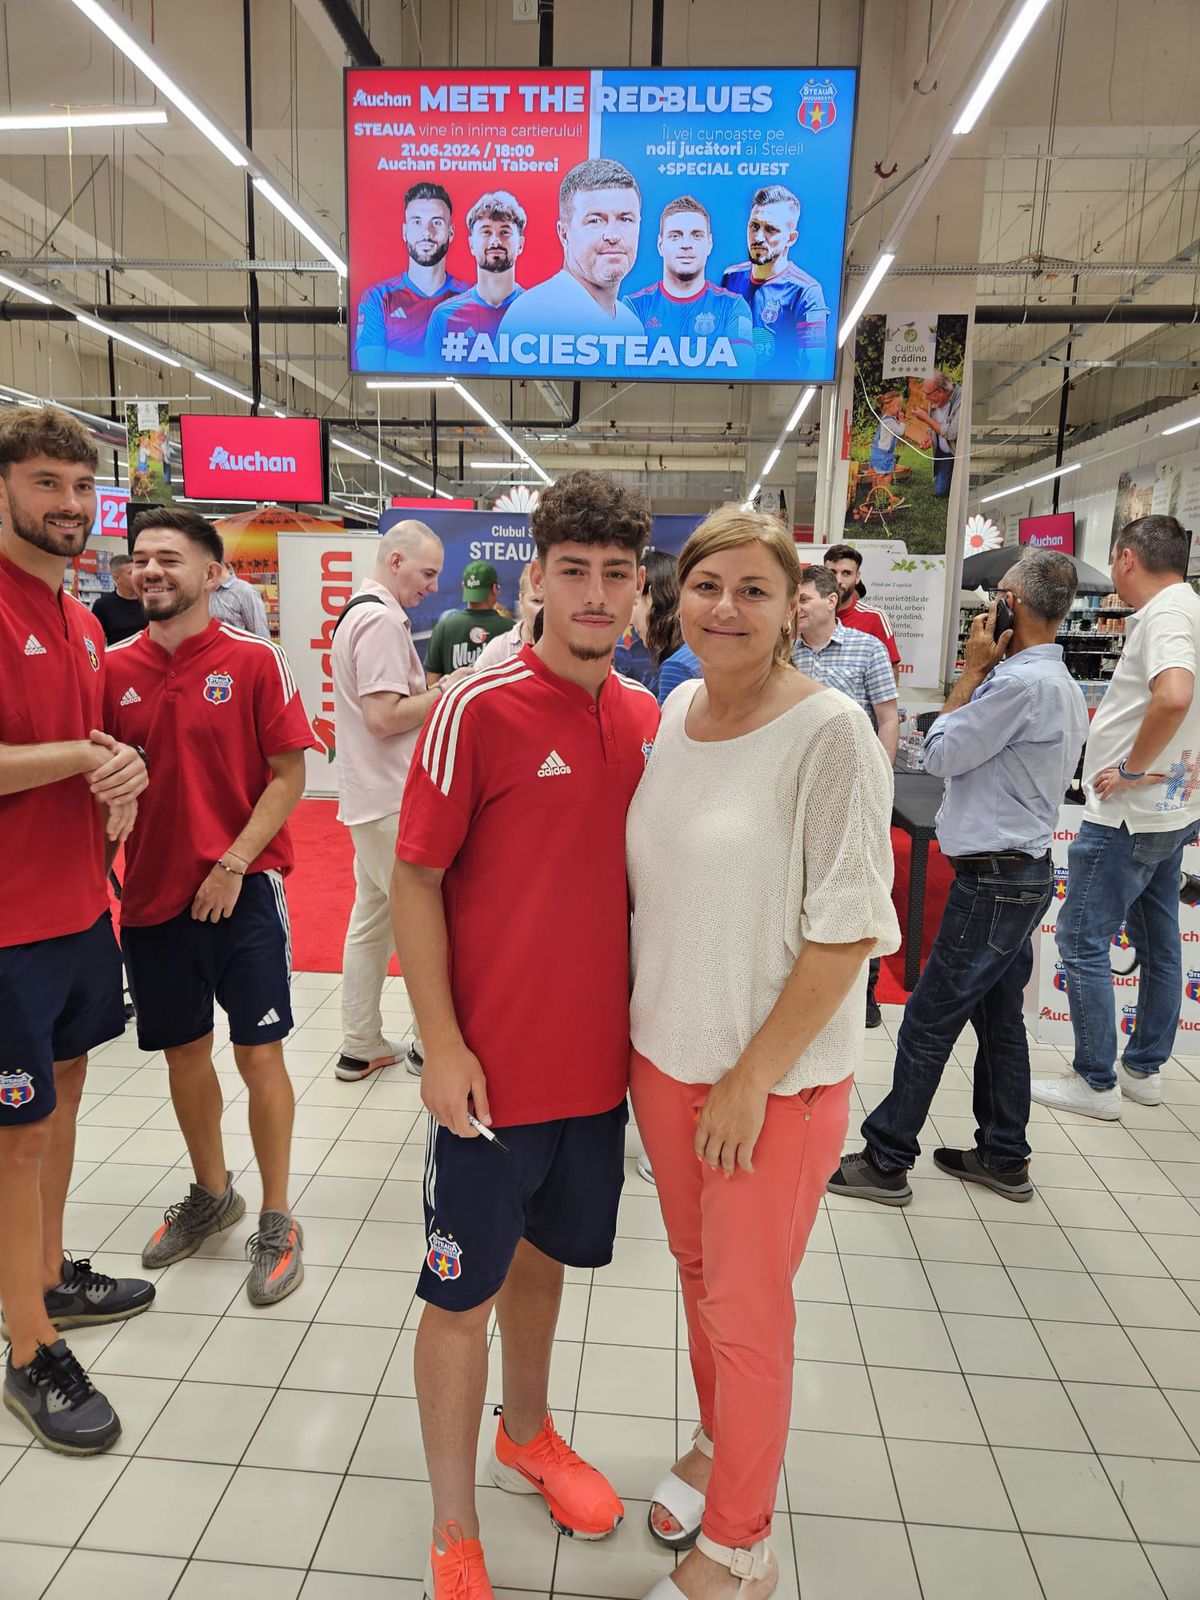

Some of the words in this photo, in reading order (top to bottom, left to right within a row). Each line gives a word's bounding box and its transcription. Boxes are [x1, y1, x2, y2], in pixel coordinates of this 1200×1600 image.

[803, 86, 833, 95] STEAUA
[353, 89, 411, 107] Auchan
[420, 85, 510, 112] MEET
[519, 86, 585, 112] THE
[354, 123, 416, 136] STEAUA
[418, 125, 447, 137] vine
[451, 123, 464, 137] în
[468, 123, 507, 137] inima
[511, 123, 583, 137] cartierului!
[674, 127, 693, 140] vei
[697, 127, 761, 142] cunoaște
[766, 129, 785, 144] pe
[401, 143, 481, 157] 21.06.2024
[484, 142, 492, 158] /
[494, 143, 535, 158] 18:00
[646, 141, 676, 156] noii
[678, 141, 742, 159] jucători
[745, 142, 758, 156] ai
[762, 141, 804, 156] Stelei!
[377, 158, 435, 171] Auchan
[440, 158, 497, 172] Drumul
[501, 158, 559, 172] Taberei
[658, 162, 734, 176] +SPECIAL
[737, 162, 790, 176] GUEST
[441, 331, 738, 368] #AICIESTEAUA
[891, 353, 927, 365] grădina
[209, 446, 297, 473] Auchan
[491, 525, 525, 538] Clubul
[1029, 534, 1063, 547] Auchan
[537, 765, 572, 778] adidas
